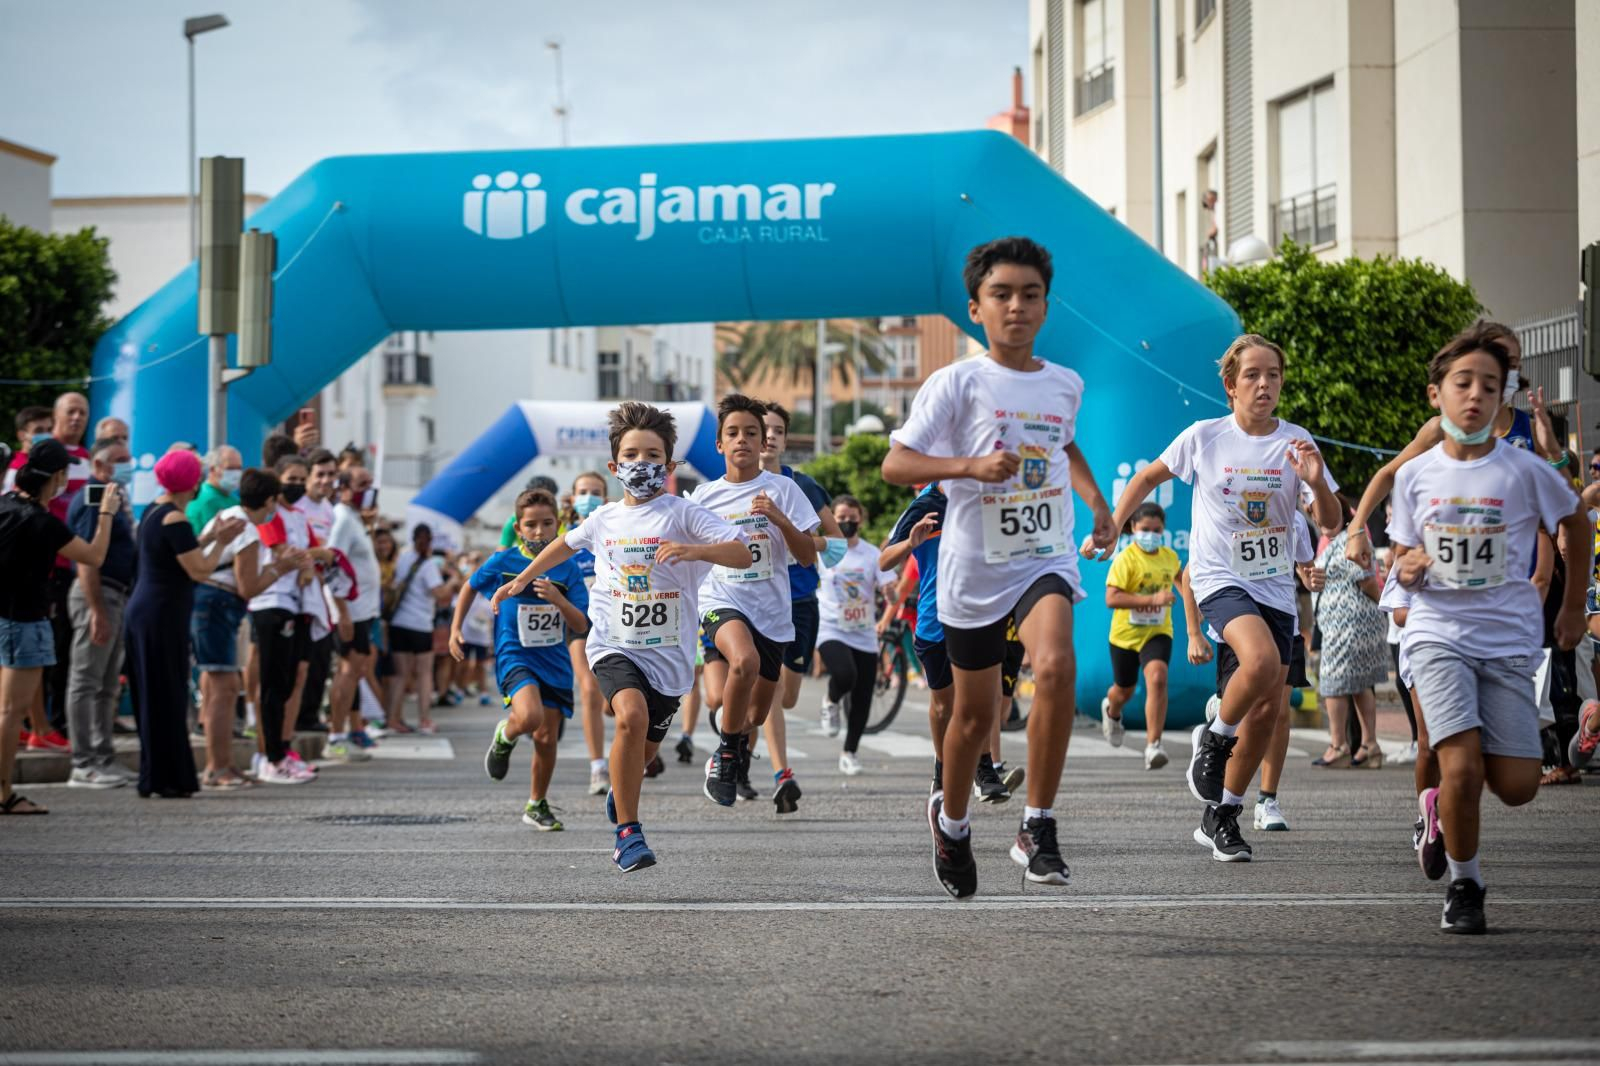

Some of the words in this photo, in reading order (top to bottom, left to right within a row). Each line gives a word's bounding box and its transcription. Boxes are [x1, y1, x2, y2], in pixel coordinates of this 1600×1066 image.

[564, 172, 836, 241] cajamar
[699, 226, 753, 244] CAJA
[760, 225, 829, 242] RURAL
[1264, 468, 1282, 476] VERDE
[1040, 488, 1063, 499] VERDE
[1000, 502, 1051, 536] 530
[639, 537, 660, 545] VERDE
[1241, 536, 1279, 562] 518
[1438, 537, 1494, 565] 514
[655, 591, 680, 600] VERDE
[528, 611, 560, 631] 524
[621, 602, 668, 628] 528
